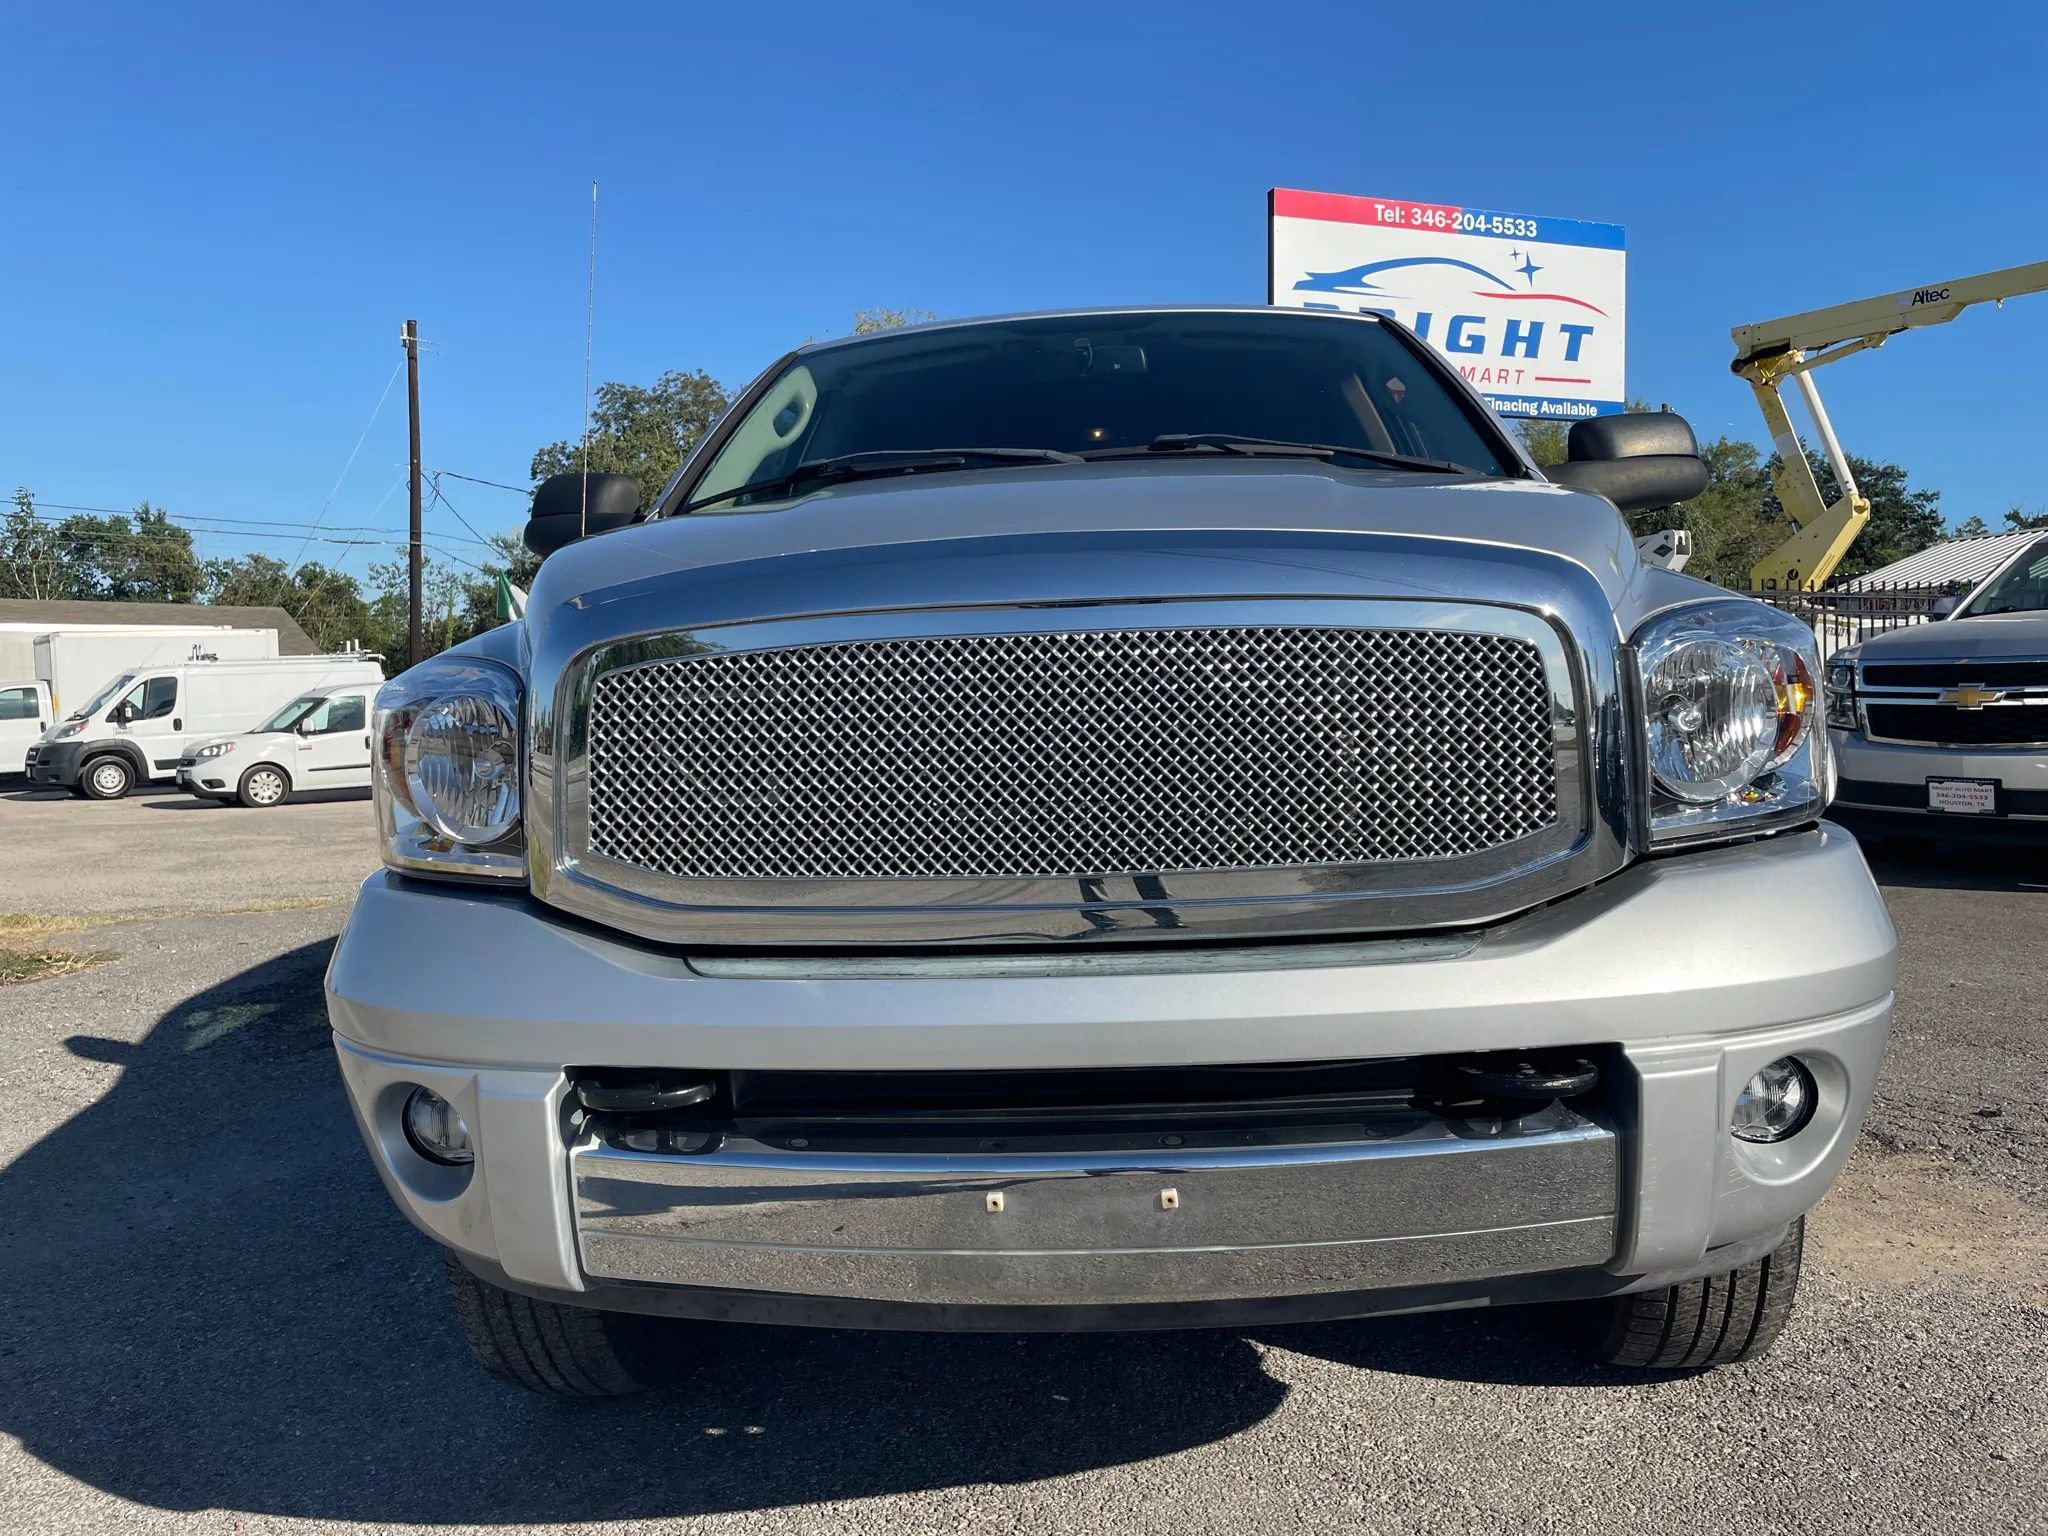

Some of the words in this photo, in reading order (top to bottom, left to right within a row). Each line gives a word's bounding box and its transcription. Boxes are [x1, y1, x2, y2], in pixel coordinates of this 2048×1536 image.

[1374, 204, 1405, 223] Tel:
[1411, 208, 1537, 237] 346-204-5533
[1912, 289, 1950, 306] Altec
[1304, 302, 1594, 362] IGHT
[1459, 366, 1525, 385] MART
[1541, 401, 1598, 416] Available
